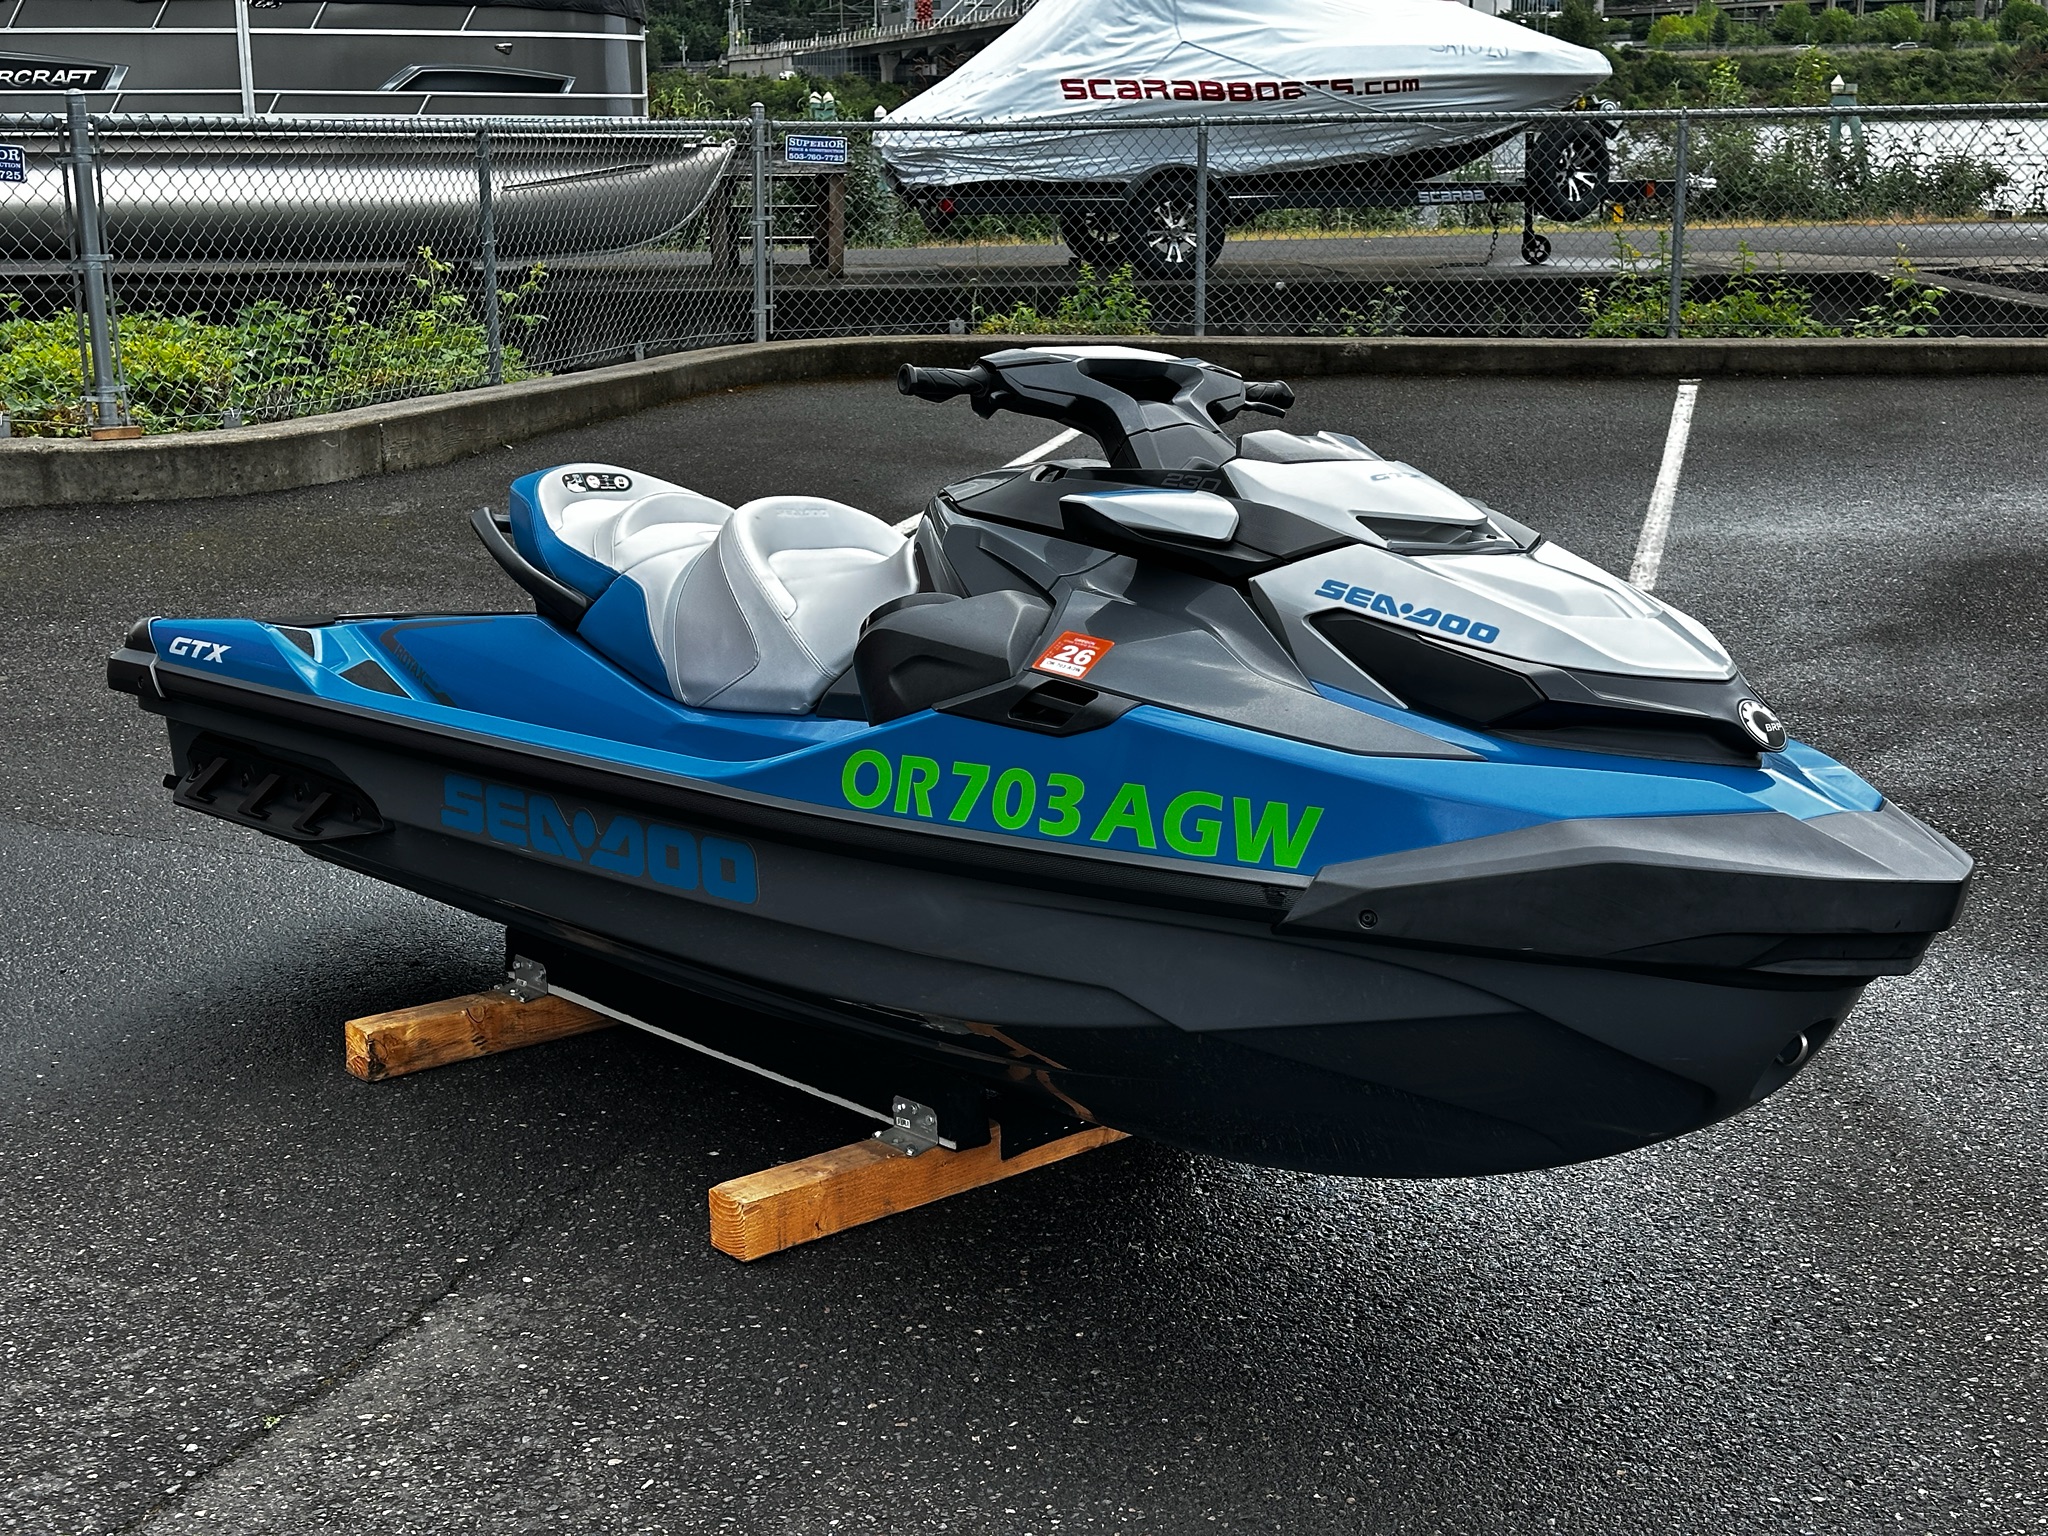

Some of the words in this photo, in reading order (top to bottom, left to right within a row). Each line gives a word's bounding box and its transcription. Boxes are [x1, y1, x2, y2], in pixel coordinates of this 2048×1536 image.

[788, 138, 844, 148] SUPERIOR
[788, 153, 844, 162] 503-760-7725
[1161, 473, 1221, 492] 230
[169, 636, 232, 664] GTX
[1053, 645, 1096, 666] 26
[1089, 782, 1325, 870] AGW
